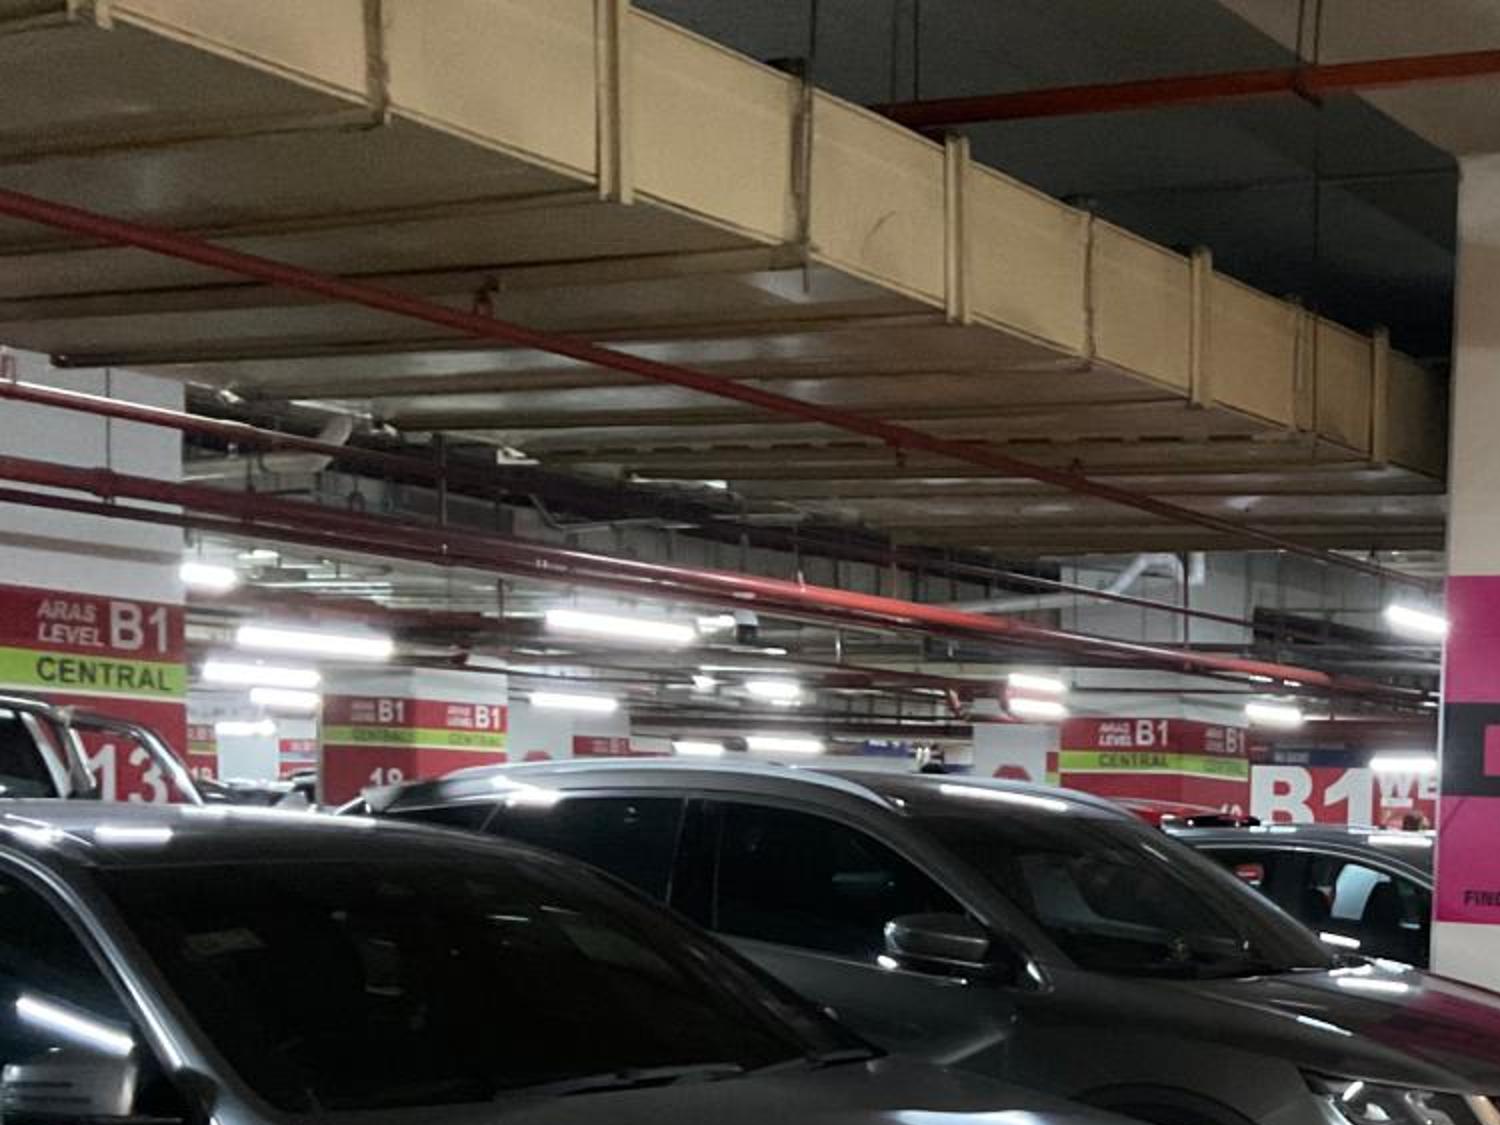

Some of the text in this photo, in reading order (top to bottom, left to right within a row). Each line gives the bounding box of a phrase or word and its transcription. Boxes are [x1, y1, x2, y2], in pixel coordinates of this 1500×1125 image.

[37, 600, 97, 621] ARAS
[38, 625, 106, 647] LEVEL
[109, 602, 168, 653] B1
[36, 657, 171, 691] CENTRAL
[378, 699, 405, 722] B1
[475, 706, 500, 730] B1
[1136, 720, 1169, 747] B1
[1225, 727, 1246, 753] B1
[1099, 753, 1169, 768] CENTRAL
[1251, 765, 1374, 825] B1
